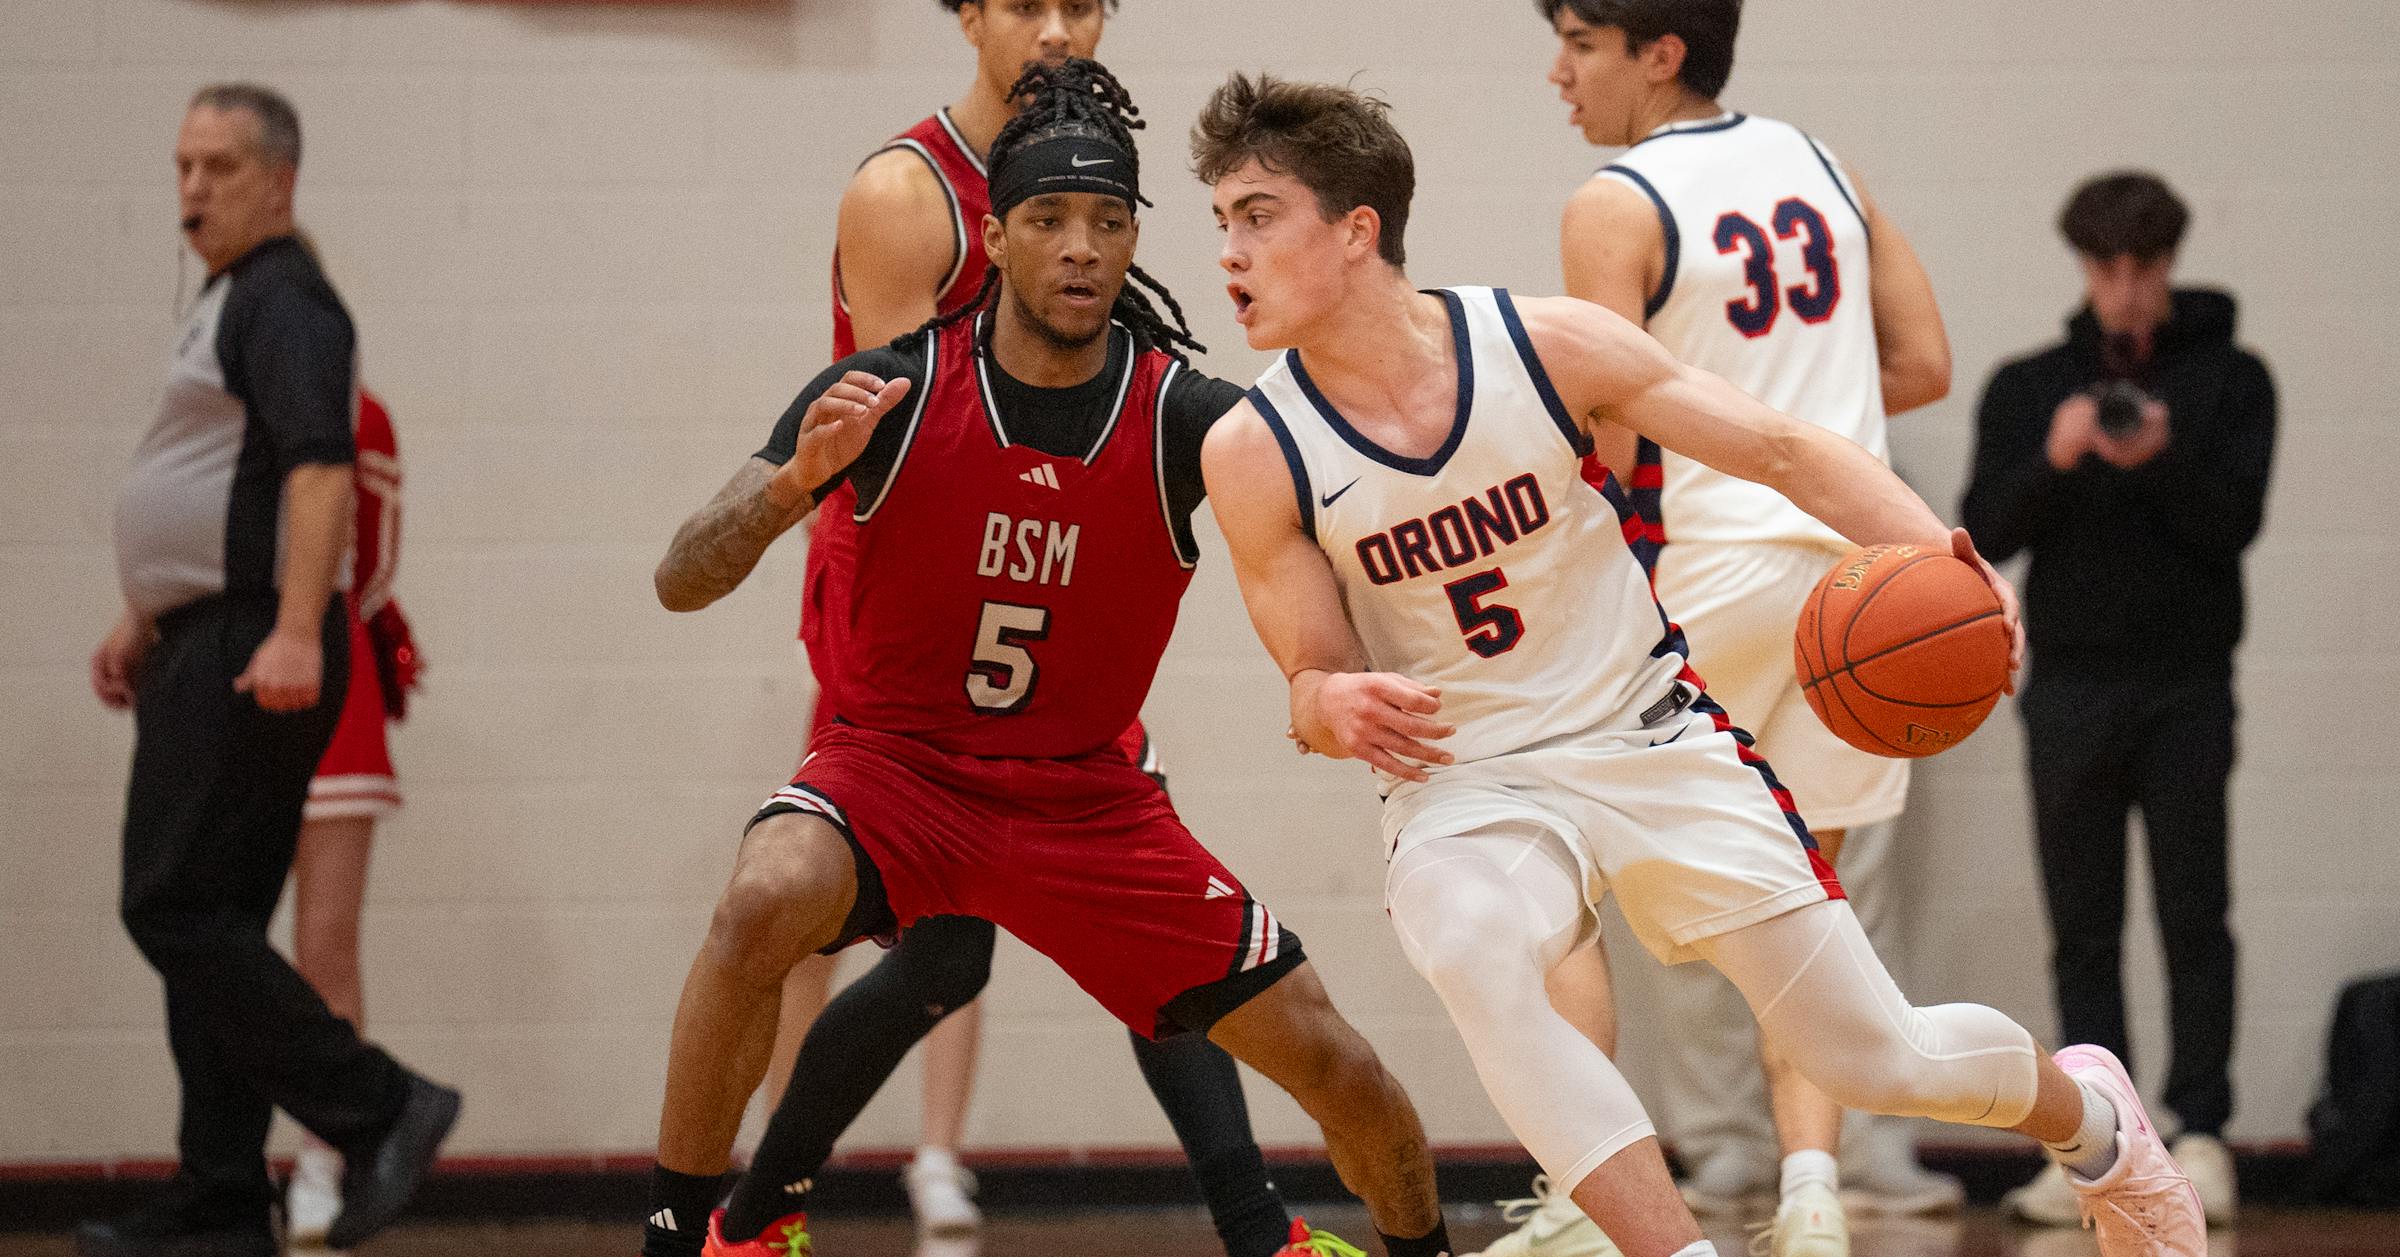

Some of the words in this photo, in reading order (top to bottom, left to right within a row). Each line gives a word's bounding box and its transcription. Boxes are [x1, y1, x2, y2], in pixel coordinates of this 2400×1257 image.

[1712, 197, 1841, 340] 33
[976, 511, 1081, 587] BSM
[1355, 472, 1550, 586] ORONO
[965, 600, 1050, 717] 5
[1443, 567, 1526, 659] 5
